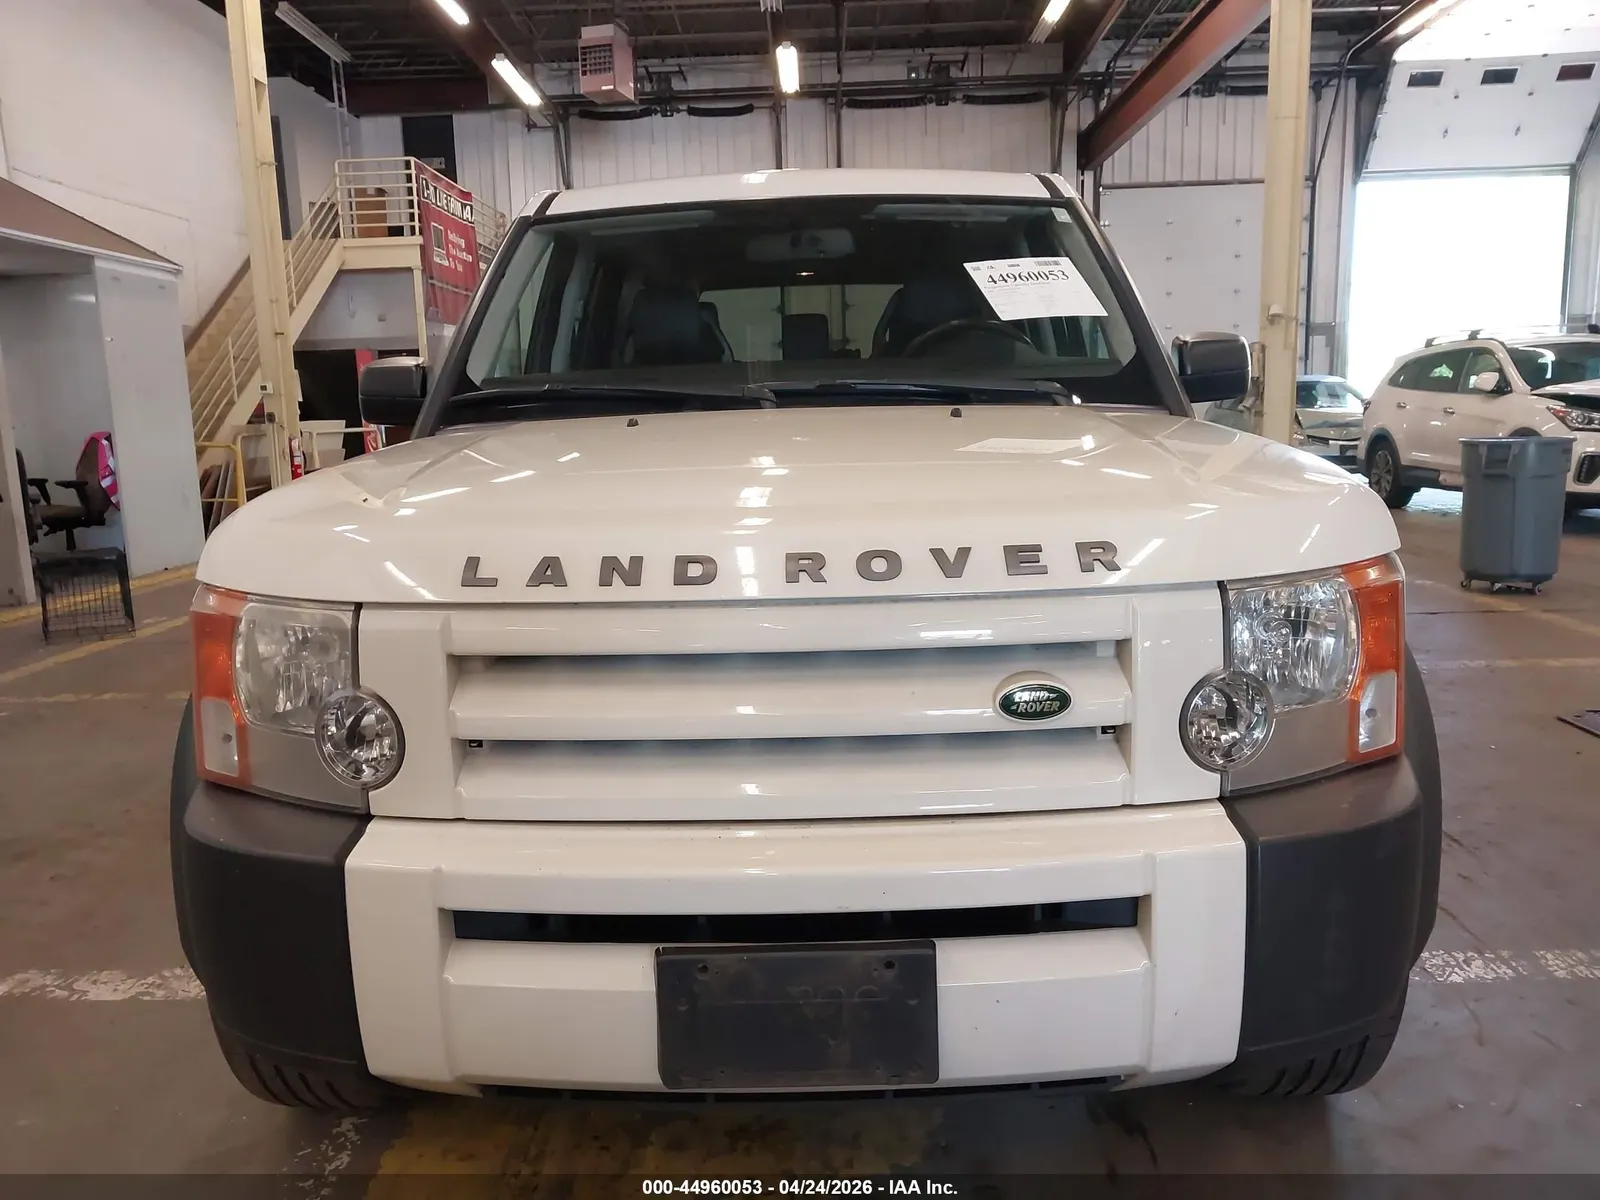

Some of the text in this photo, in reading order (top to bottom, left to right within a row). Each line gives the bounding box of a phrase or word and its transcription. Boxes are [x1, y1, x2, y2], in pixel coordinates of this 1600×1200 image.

[986, 269, 1070, 285] 44960053
[461, 541, 1122, 587] LAND ROVER
[1017, 701, 1060, 713] ROVER
